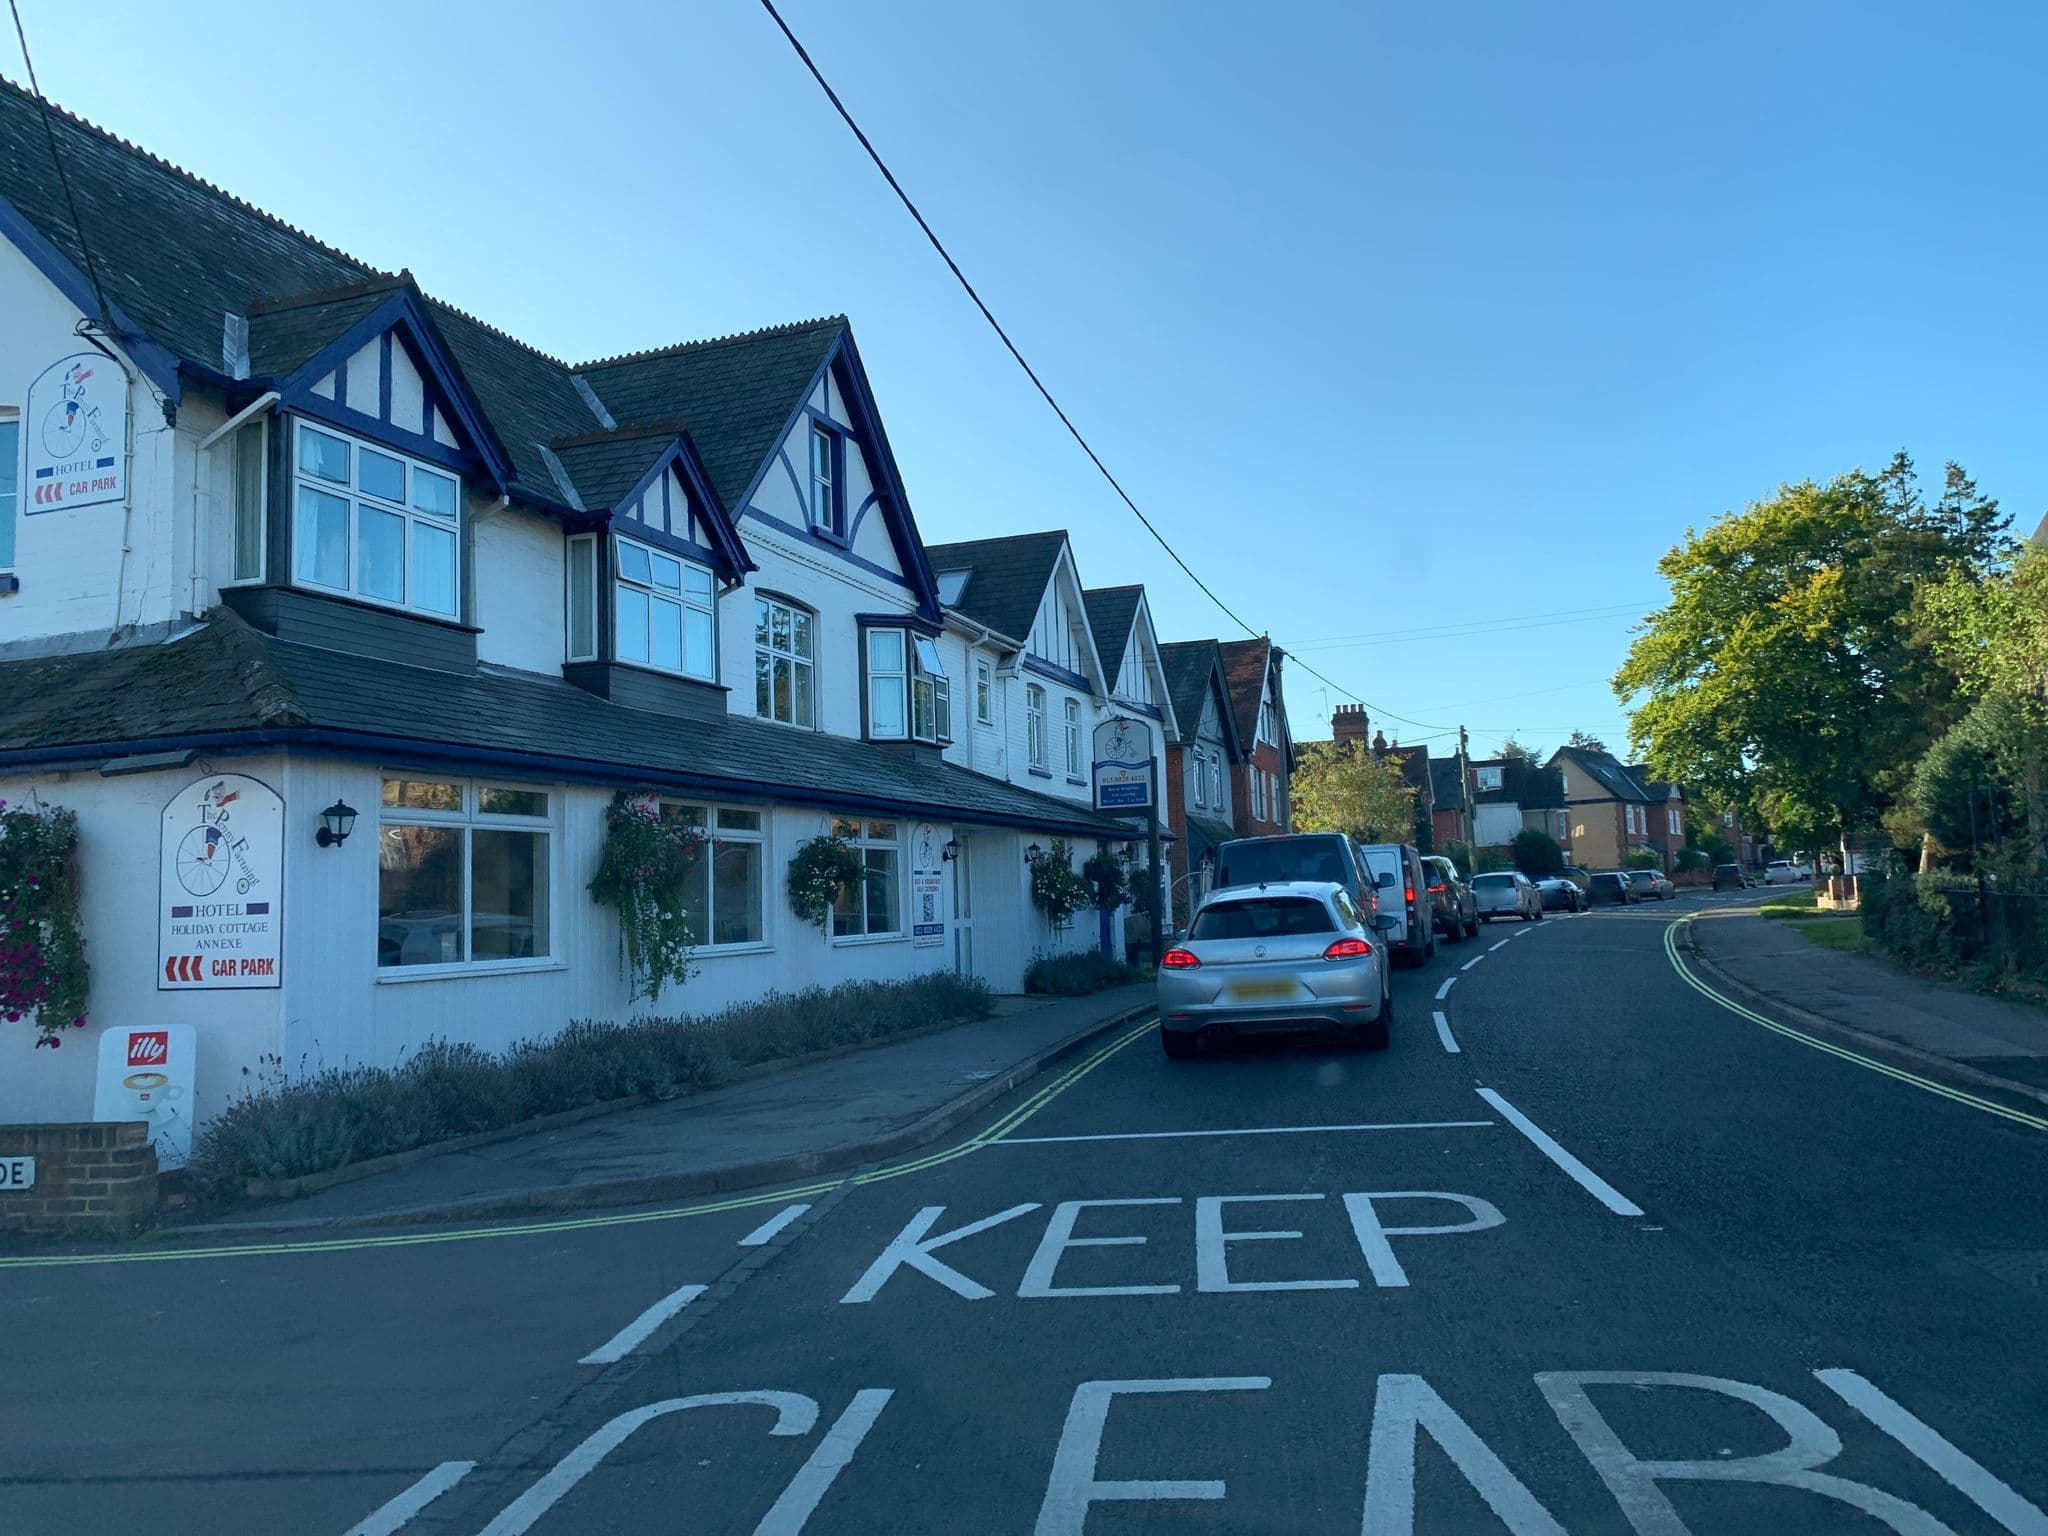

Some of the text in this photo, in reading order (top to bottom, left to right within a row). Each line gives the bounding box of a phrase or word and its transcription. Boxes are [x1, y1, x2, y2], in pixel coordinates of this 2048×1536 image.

[55, 460, 94, 476] HOTEL
[69, 476, 117, 496] CAR PARK
[197, 804, 260, 886] The Penny Farthing
[194, 903, 244, 918] HOTEL
[171, 922, 269, 936] HOLIDAY COTTAGE
[195, 938, 242, 950] ANNEXE
[212, 958, 274, 977] CAR PARK
[130, 1037, 165, 1063] illy
[840, 1191, 1507, 1304] KEEP
